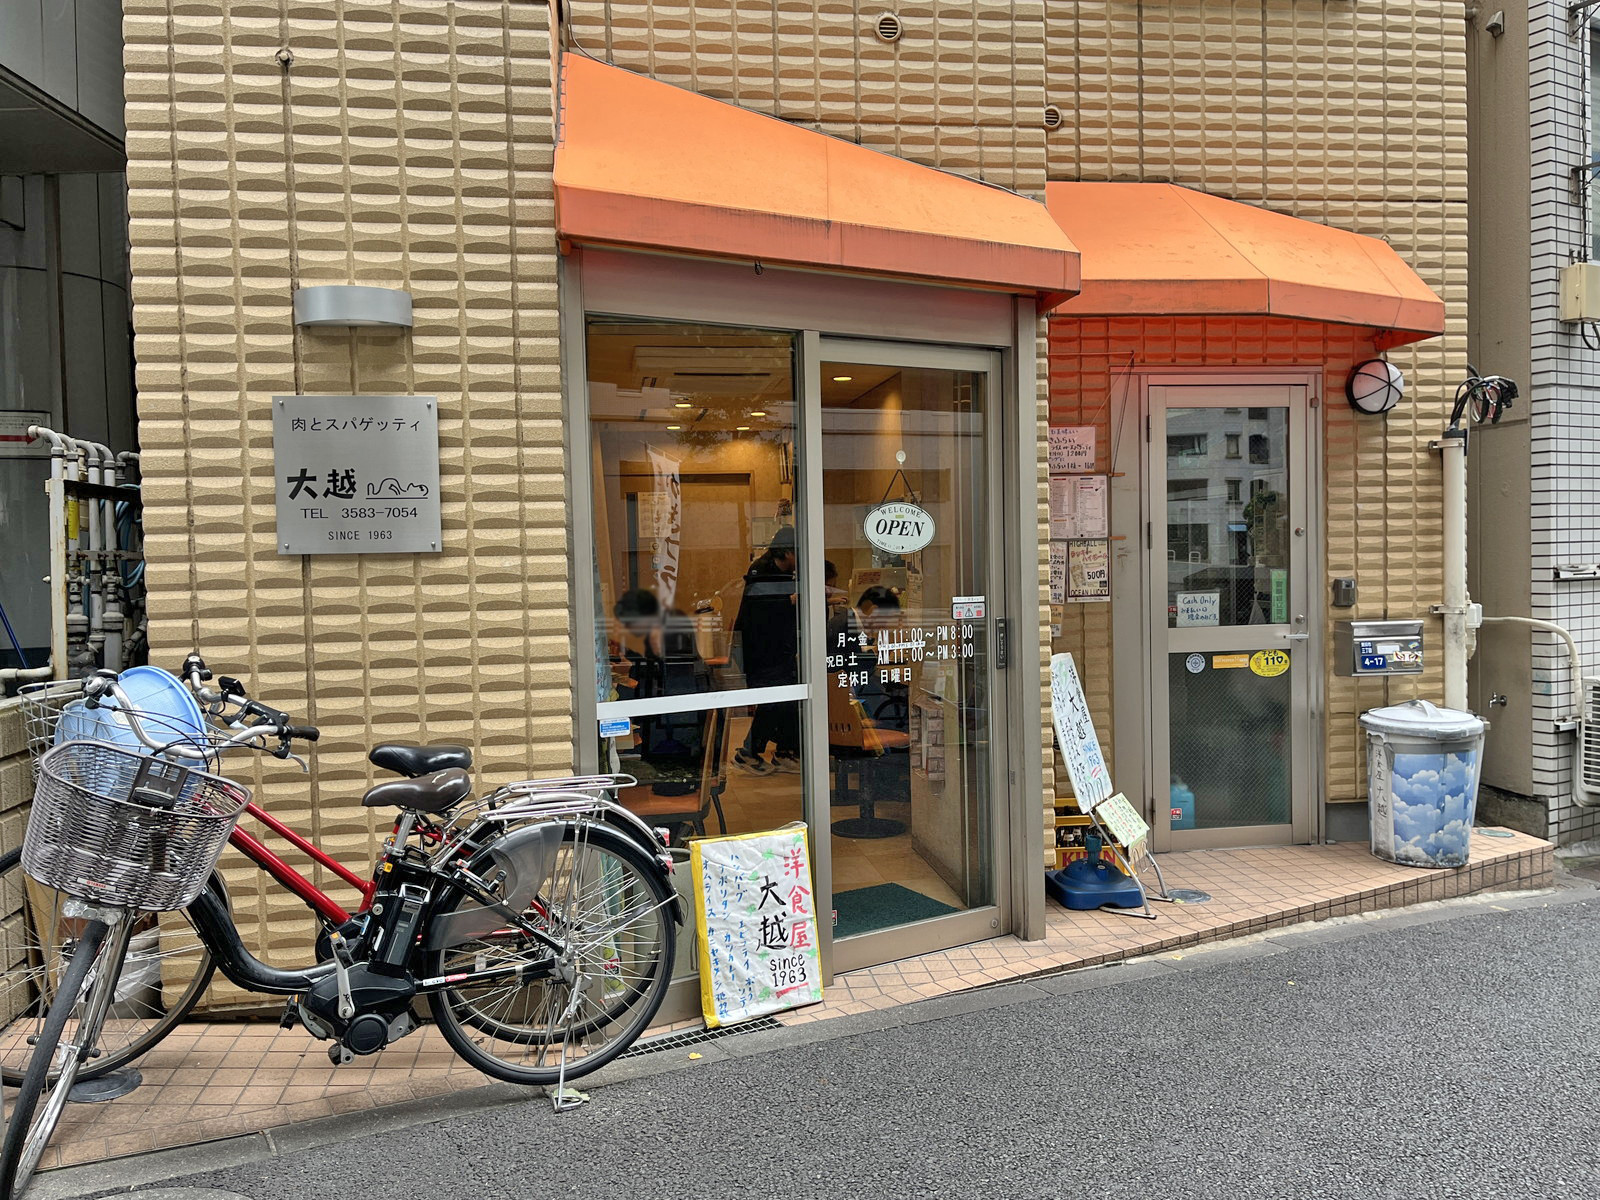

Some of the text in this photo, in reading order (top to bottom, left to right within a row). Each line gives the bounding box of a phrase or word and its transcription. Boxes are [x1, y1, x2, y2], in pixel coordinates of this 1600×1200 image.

[291, 417, 420, 432] 肉とスパゲッティ
[287, 468, 357, 501] 大越
[300, 507, 418, 519] TEL 3583-7054
[881, 506, 922, 519] WELCOME
[328, 530, 393, 540] SINCE 1963
[876, 518, 925, 537] OPEN
[1183, 596, 1217, 606] Cash Only
[937, 626, 948, 641] PM
[951, 624, 973, 640] 8:00
[937, 645, 948, 660] PM
[951, 643, 974, 659] 3:00
[1364, 657, 1384, 666] 4-17
[838, 667, 911, 688] 定休日 日曜日
[784, 847, 811, 949] 洋食屋
[756, 875, 789, 950] 大越
[769, 953, 805, 972] since
[771, 967, 807, 987] 1963
